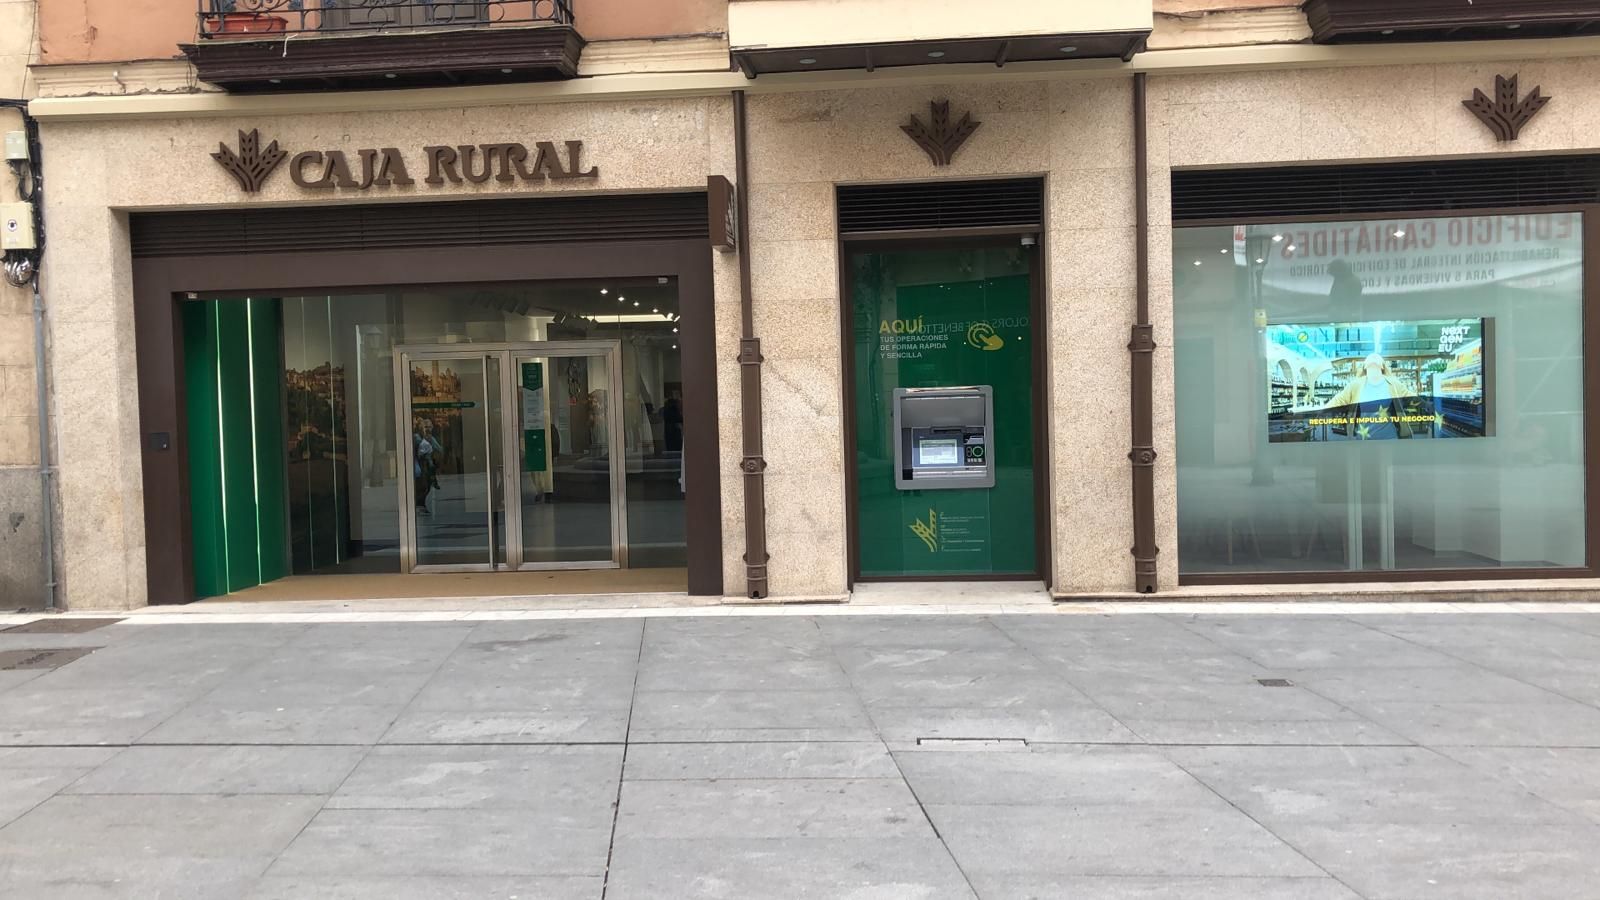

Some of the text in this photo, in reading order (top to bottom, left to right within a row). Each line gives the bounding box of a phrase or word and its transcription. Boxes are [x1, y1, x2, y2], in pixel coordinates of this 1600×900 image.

[289, 140, 599, 190] CAJA RURAL
[879, 314, 924, 334] AQUÍ
[880, 334, 949, 343] TUS OPERACIONES
[891, 343, 918, 351] FORMA
[1438, 343, 1453, 353] EU
[1309, 417, 1348, 425] RECUPERA
[1356, 416, 1388, 424] IMPULSA
